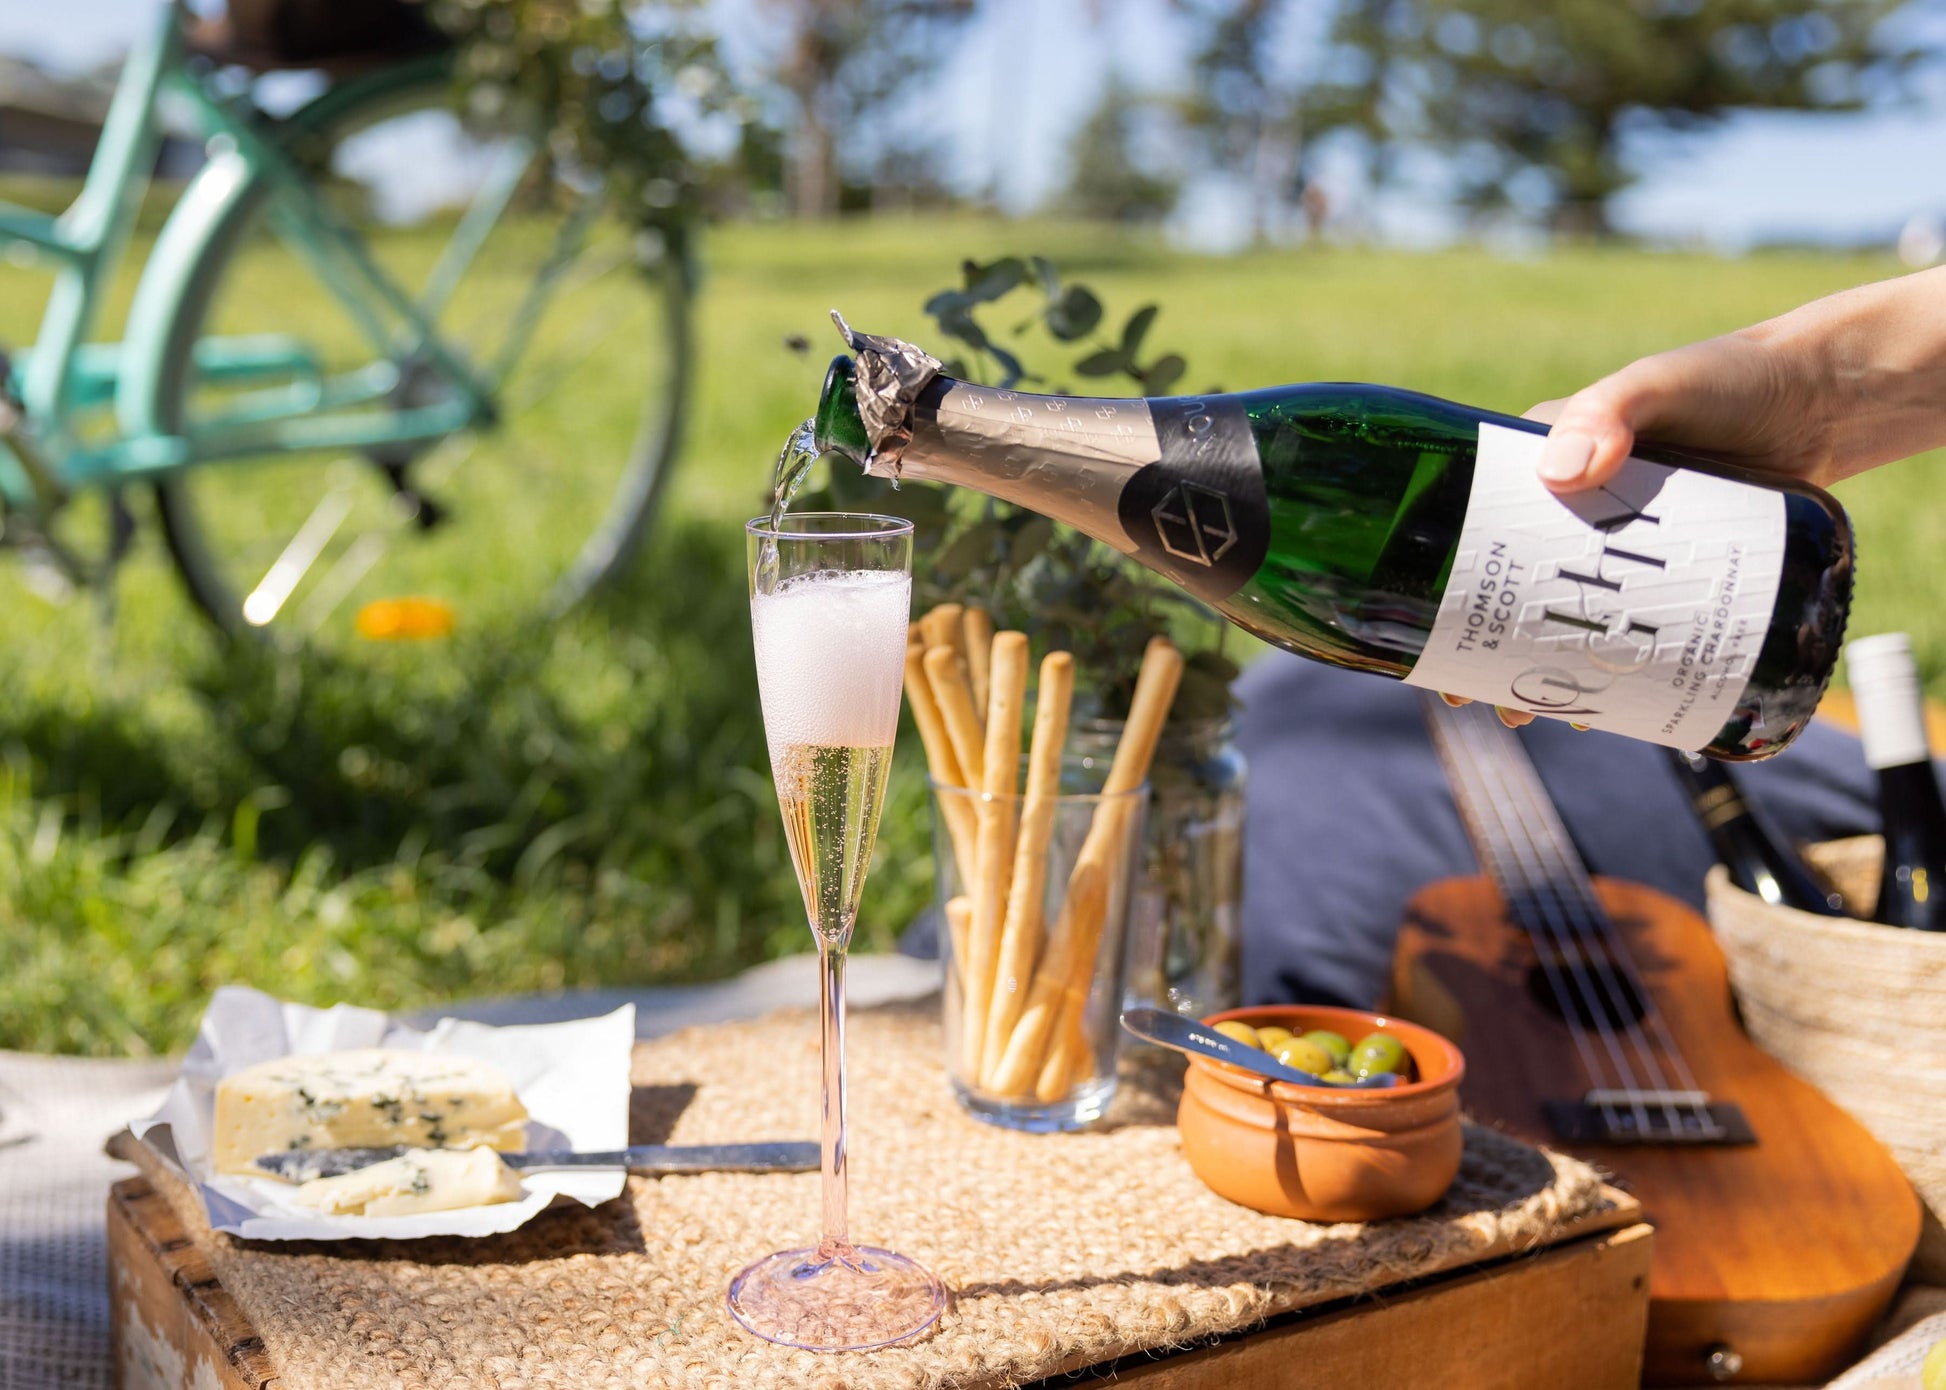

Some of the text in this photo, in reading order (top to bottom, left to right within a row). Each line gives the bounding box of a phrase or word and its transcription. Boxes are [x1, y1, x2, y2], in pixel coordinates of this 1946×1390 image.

[1456, 540, 1507, 653] THOMSON
[1661, 546, 1742, 735] SPARKLING CHARDONNAY
[1672, 610, 1709, 688] ORGANIC
